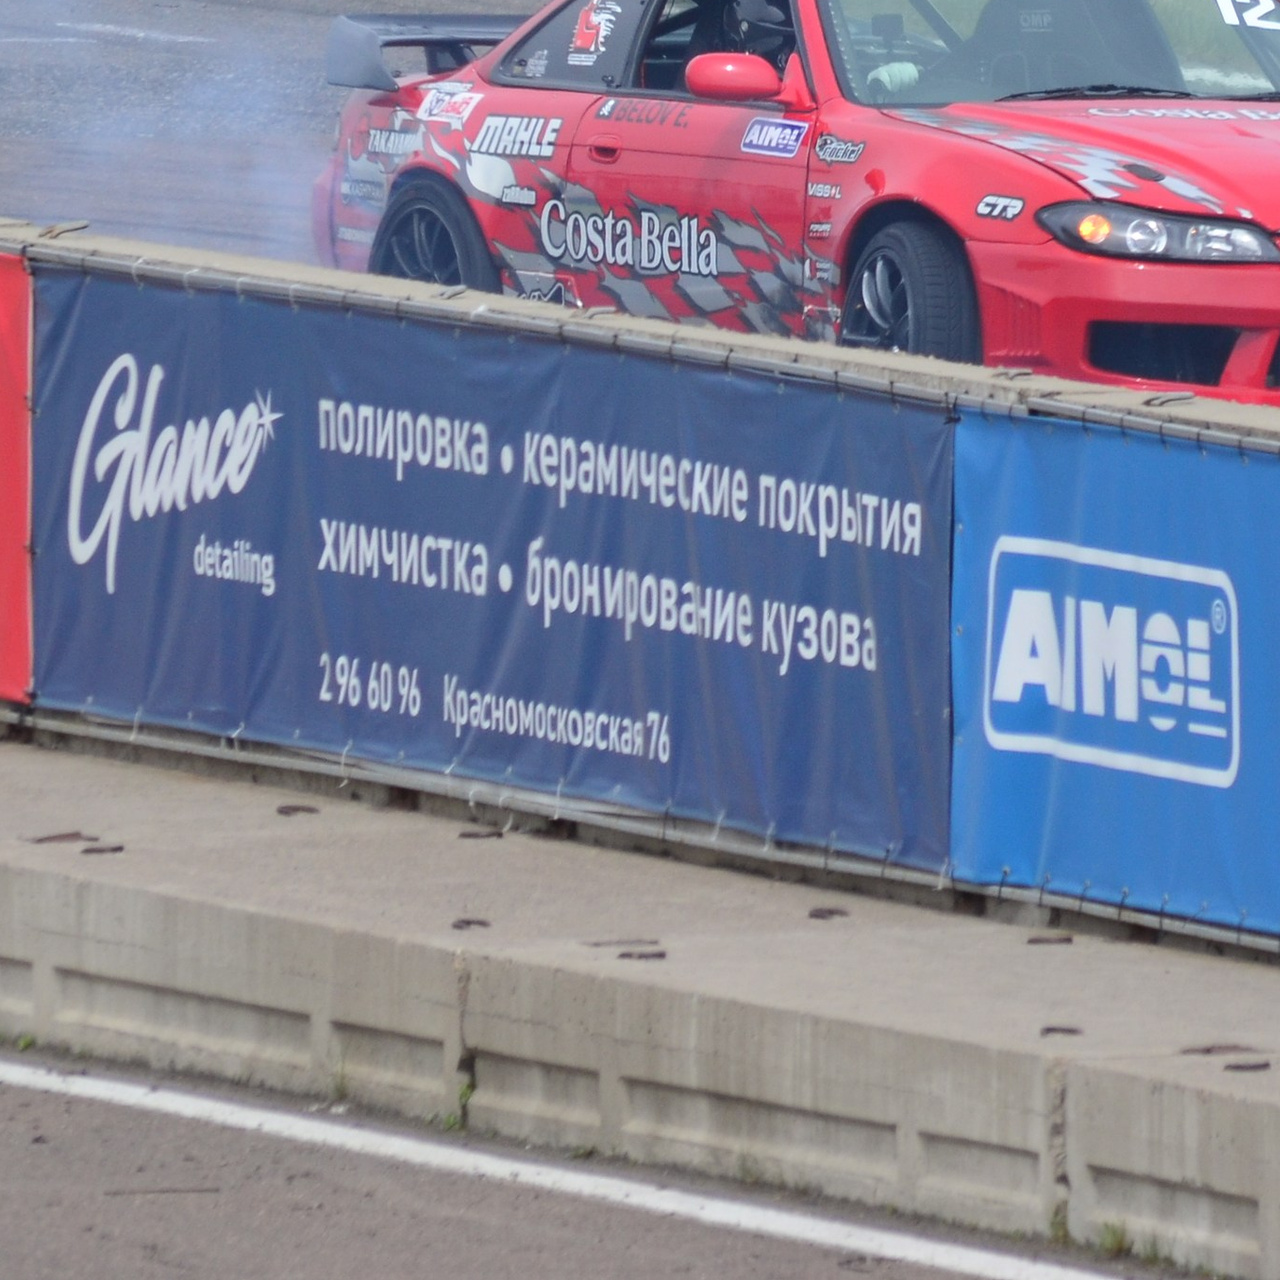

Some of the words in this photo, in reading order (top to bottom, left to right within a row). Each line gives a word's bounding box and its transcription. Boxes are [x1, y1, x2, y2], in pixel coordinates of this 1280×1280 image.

[470, 115, 562, 158] MAHLE
[743, 122, 802, 152] AIMOL
[540, 199, 635, 267] Costa
[639, 211, 719, 276] Bella
[68, 353, 268, 594] Glance
[317, 398, 489, 481] полировка
[522, 430, 749, 522] керамические
[757, 473, 922, 557] покрытия
[193, 533, 276, 597] detailing
[317, 517, 488, 597] химчистка
[525, 536, 753, 647] бронирование
[761, 599, 878, 676] кузова
[366, 660, 393, 713] 60
[397, 665, 421, 717] 96
[443, 673, 644, 757] Красномосковская
[646, 711, 671, 763] 76
